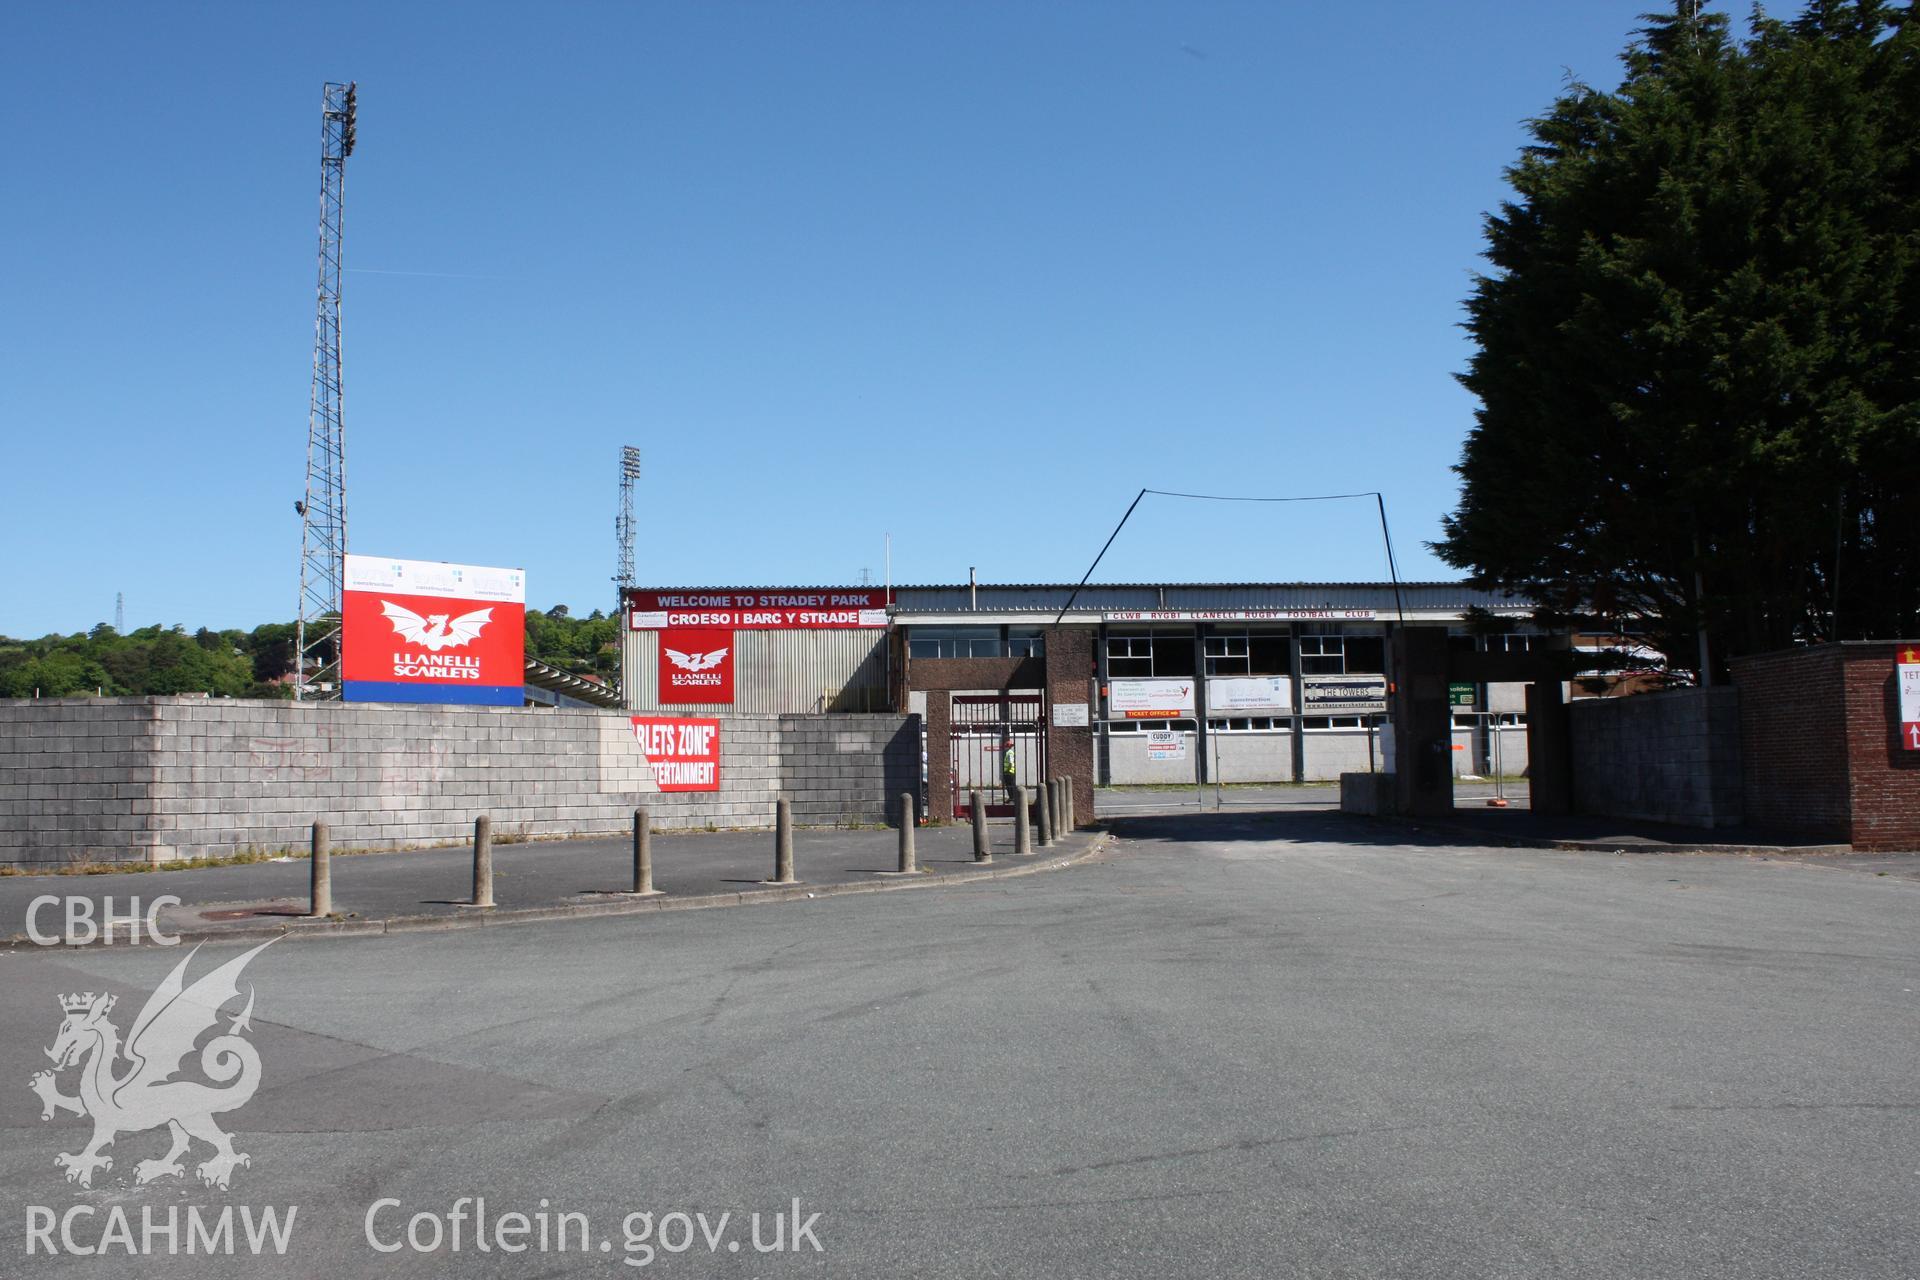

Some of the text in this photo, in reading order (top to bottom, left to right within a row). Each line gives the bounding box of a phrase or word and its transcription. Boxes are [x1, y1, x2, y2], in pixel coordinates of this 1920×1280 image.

[658, 595, 870, 607] WELCOME TO STRADEY PARK
[669, 613, 730, 625] CROESO
[734, 613, 739, 624] I
[743, 613, 781, 624] BARC
[785, 613, 796, 623] Y
[800, 612, 857, 624] STRADE
[393, 666, 480, 679] SCARLETS
[1323, 687, 1369, 696] THE TOWERS
[632, 724, 675, 756] RLETS
